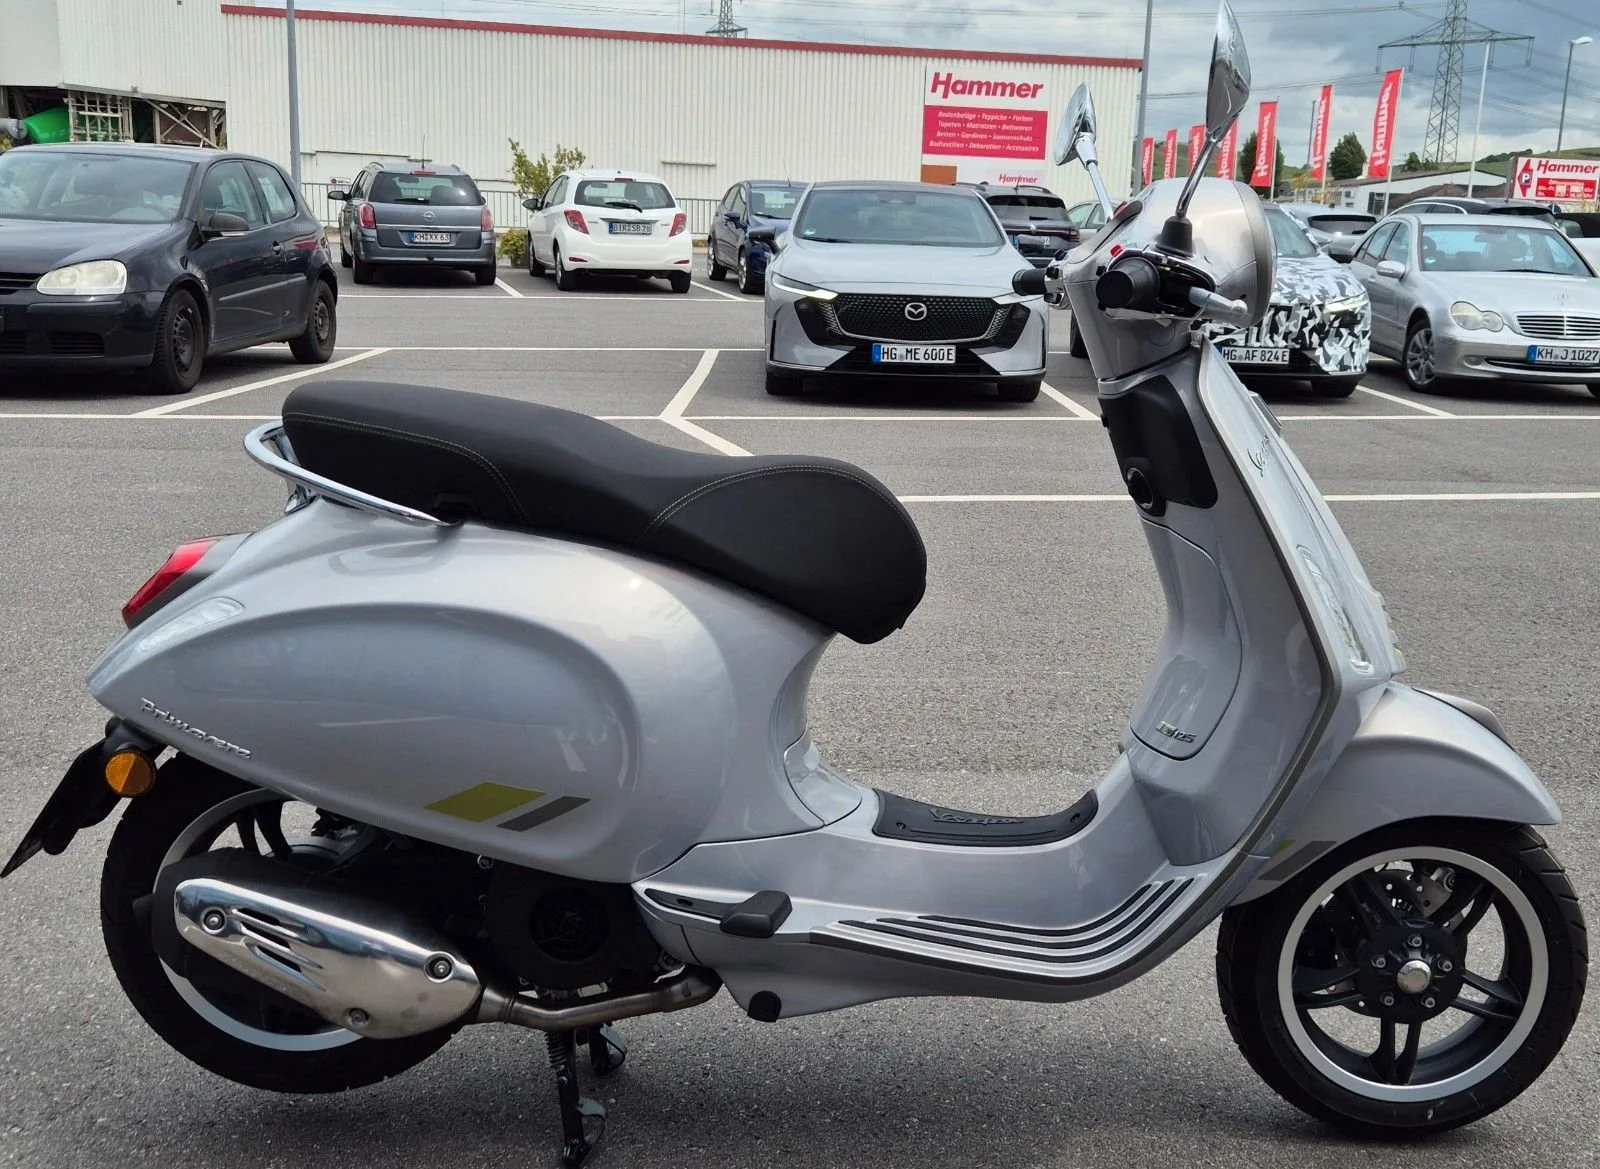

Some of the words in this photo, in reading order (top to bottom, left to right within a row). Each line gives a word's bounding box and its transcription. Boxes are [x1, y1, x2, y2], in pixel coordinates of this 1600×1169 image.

[931, 72, 1044, 99] Hammer
[938, 111, 976, 120] Bodenbeläge
[982, 113, 1007, 121] Teppiche
[966, 122, 997, 130] Matratzen
[1372, 82, 1393, 167] Hammer
[969, 142, 1001, 150] Dekoration
[1255, 112, 1271, 177] Hammer
[1164, 136, 1174, 178] ammer
[1537, 160, 1599, 174] Hammer
[998, 173, 1038, 185] Hammer
[613, 223, 628, 232] BIR
[882, 347, 897, 360] HG
[905, 347, 920, 361] ME
[1222, 349, 1237, 361] HG
[1244, 349, 1258, 361] AF
[1537, 348, 1553, 360] KH
[1560, 349, 1569, 360] J
[1571, 349, 1599, 361] 1027
